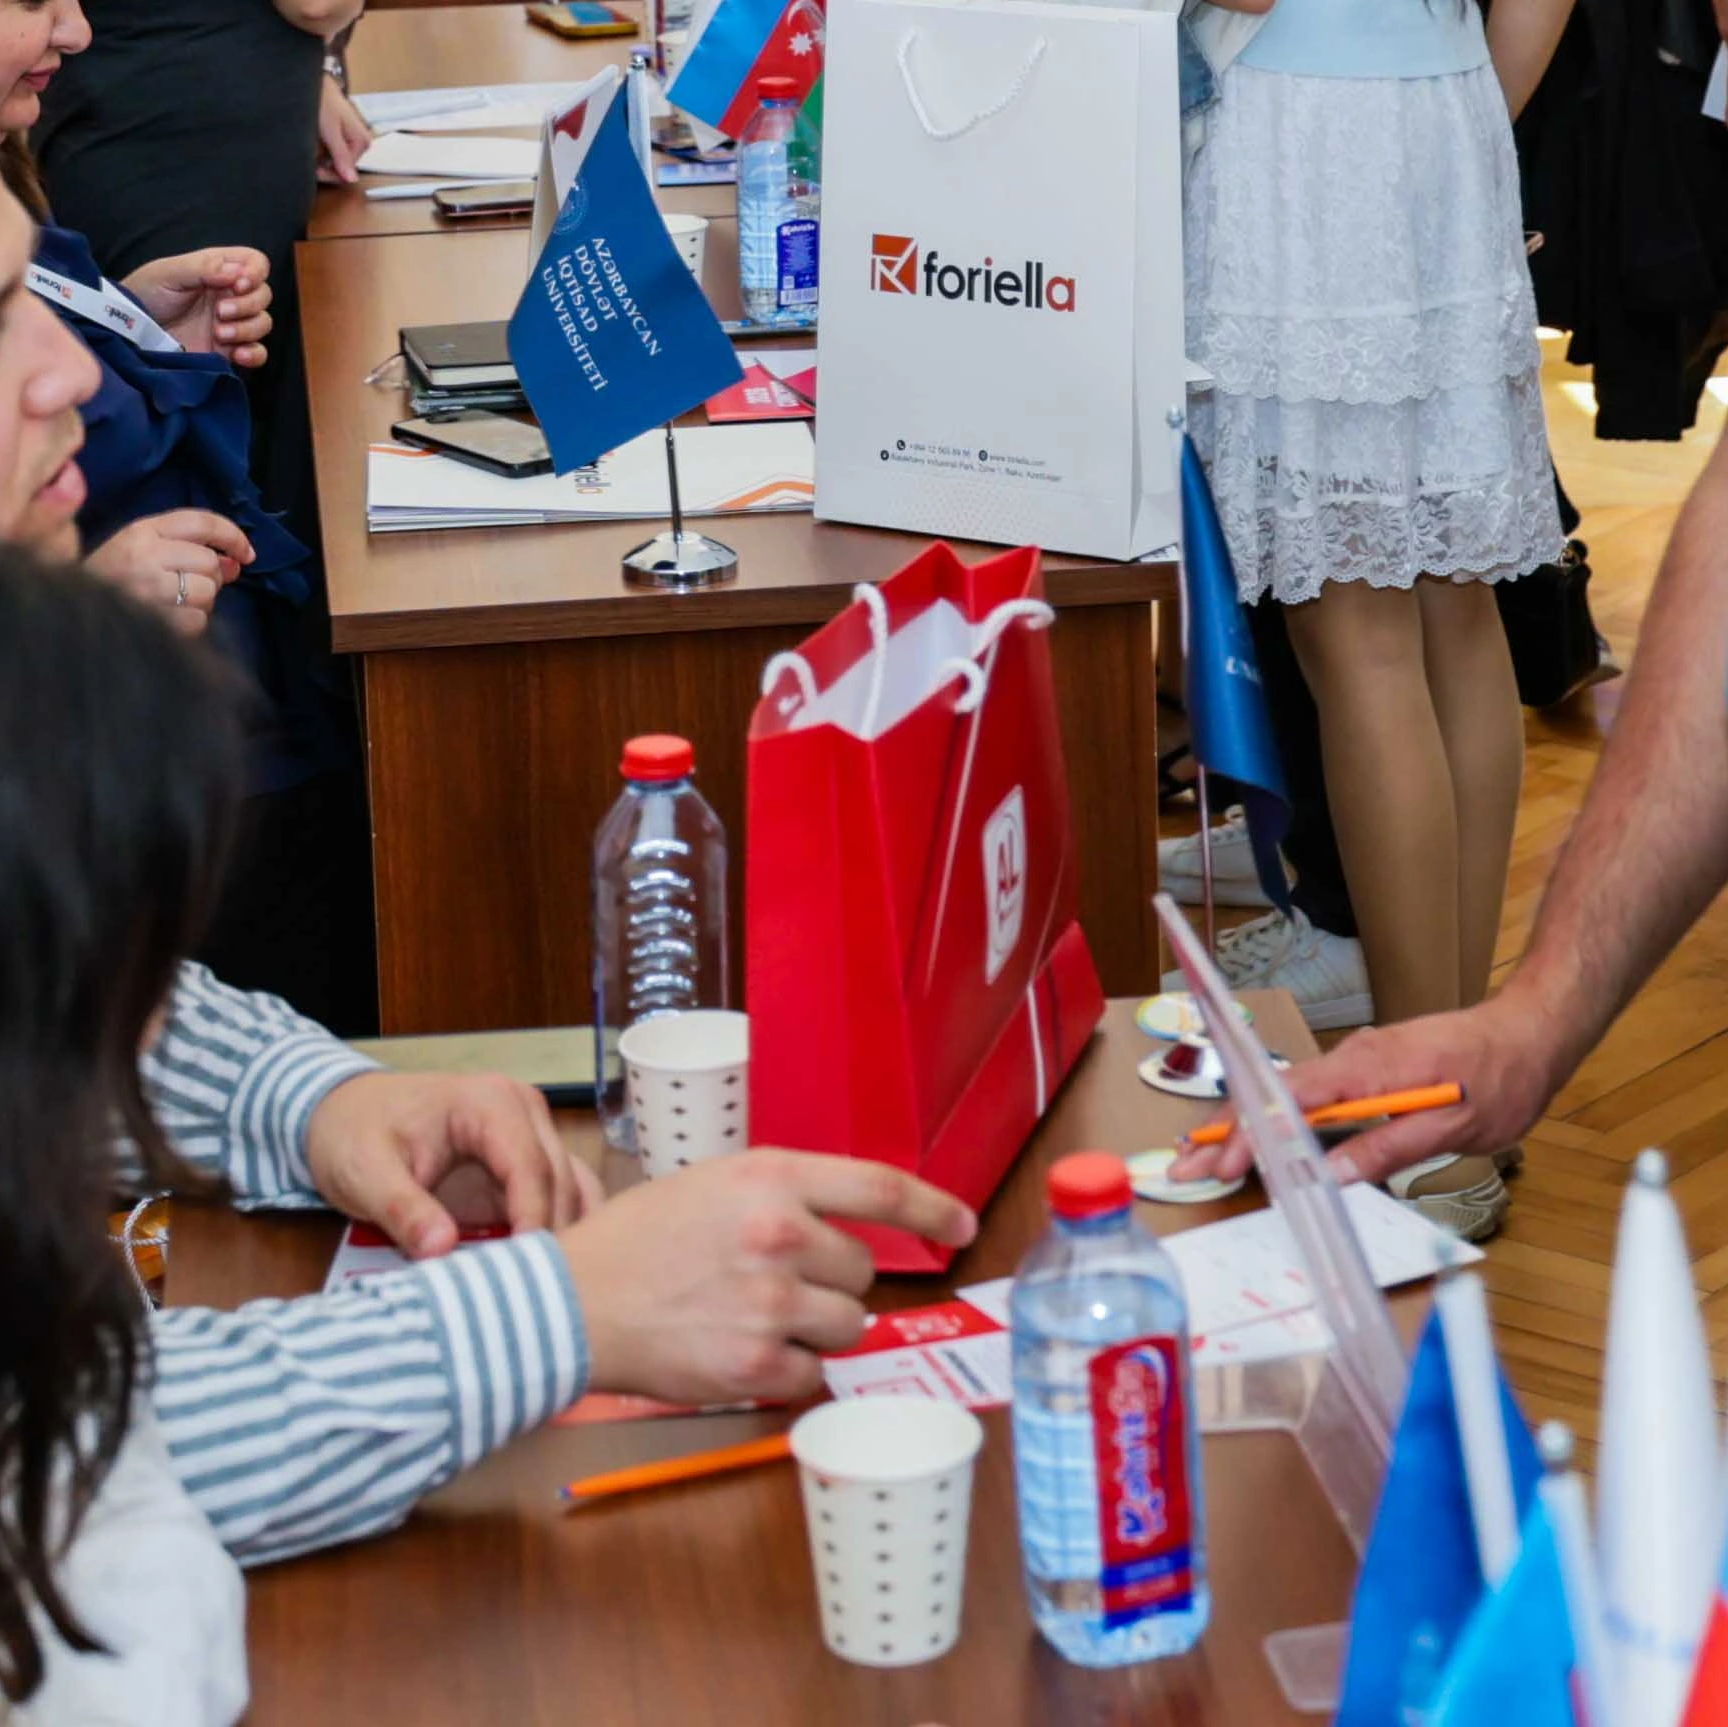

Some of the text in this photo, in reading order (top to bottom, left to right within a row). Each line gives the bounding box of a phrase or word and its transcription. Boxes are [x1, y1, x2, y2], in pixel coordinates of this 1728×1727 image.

[557, 255, 598, 333] İQTİSAD
[575, 245, 618, 322] DÖVLƏT
[592, 237, 662, 356] AZƏRBAYCAN
[923, 250, 1076, 312] foriella
[543, 266, 609, 391] UNİVERSİTETİ
